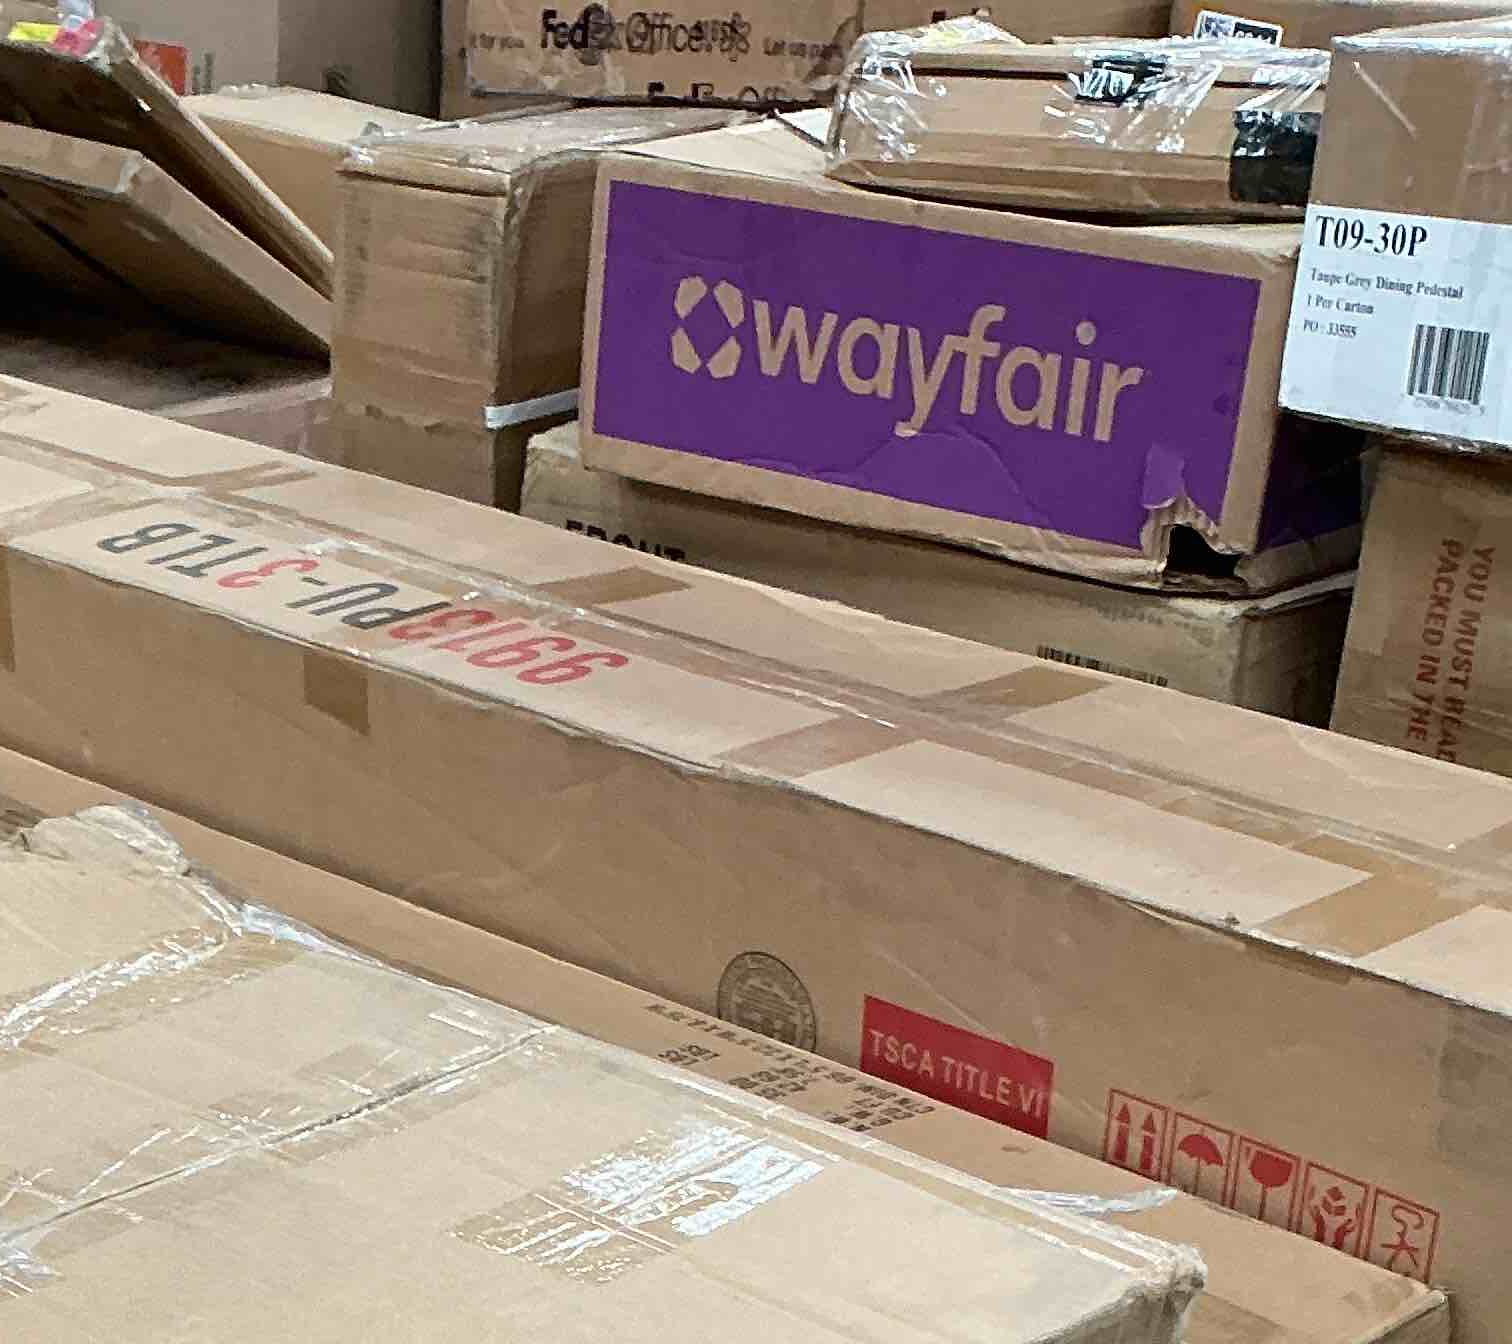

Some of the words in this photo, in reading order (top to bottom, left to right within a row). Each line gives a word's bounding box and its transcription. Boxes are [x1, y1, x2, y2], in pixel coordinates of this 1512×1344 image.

[1316, 214, 1428, 257] T09-30P
[1335, 296, 1374, 315] Carton
[1375, 275, 1413, 296] Dining
[1416, 280, 1464, 300] Pedestal
[752, 298, 1145, 442] wayfair
[1422, 537, 1465, 647] PACKED
[1464, 546, 1496, 602] YOU
[1416, 654, 1441, 686] IN
[1448, 609, 1482, 691] MUST
[868, 1027, 935, 1080] TSCA
[940, 1055, 1012, 1106] TITLE
[1017, 1082, 1048, 1119] VI
